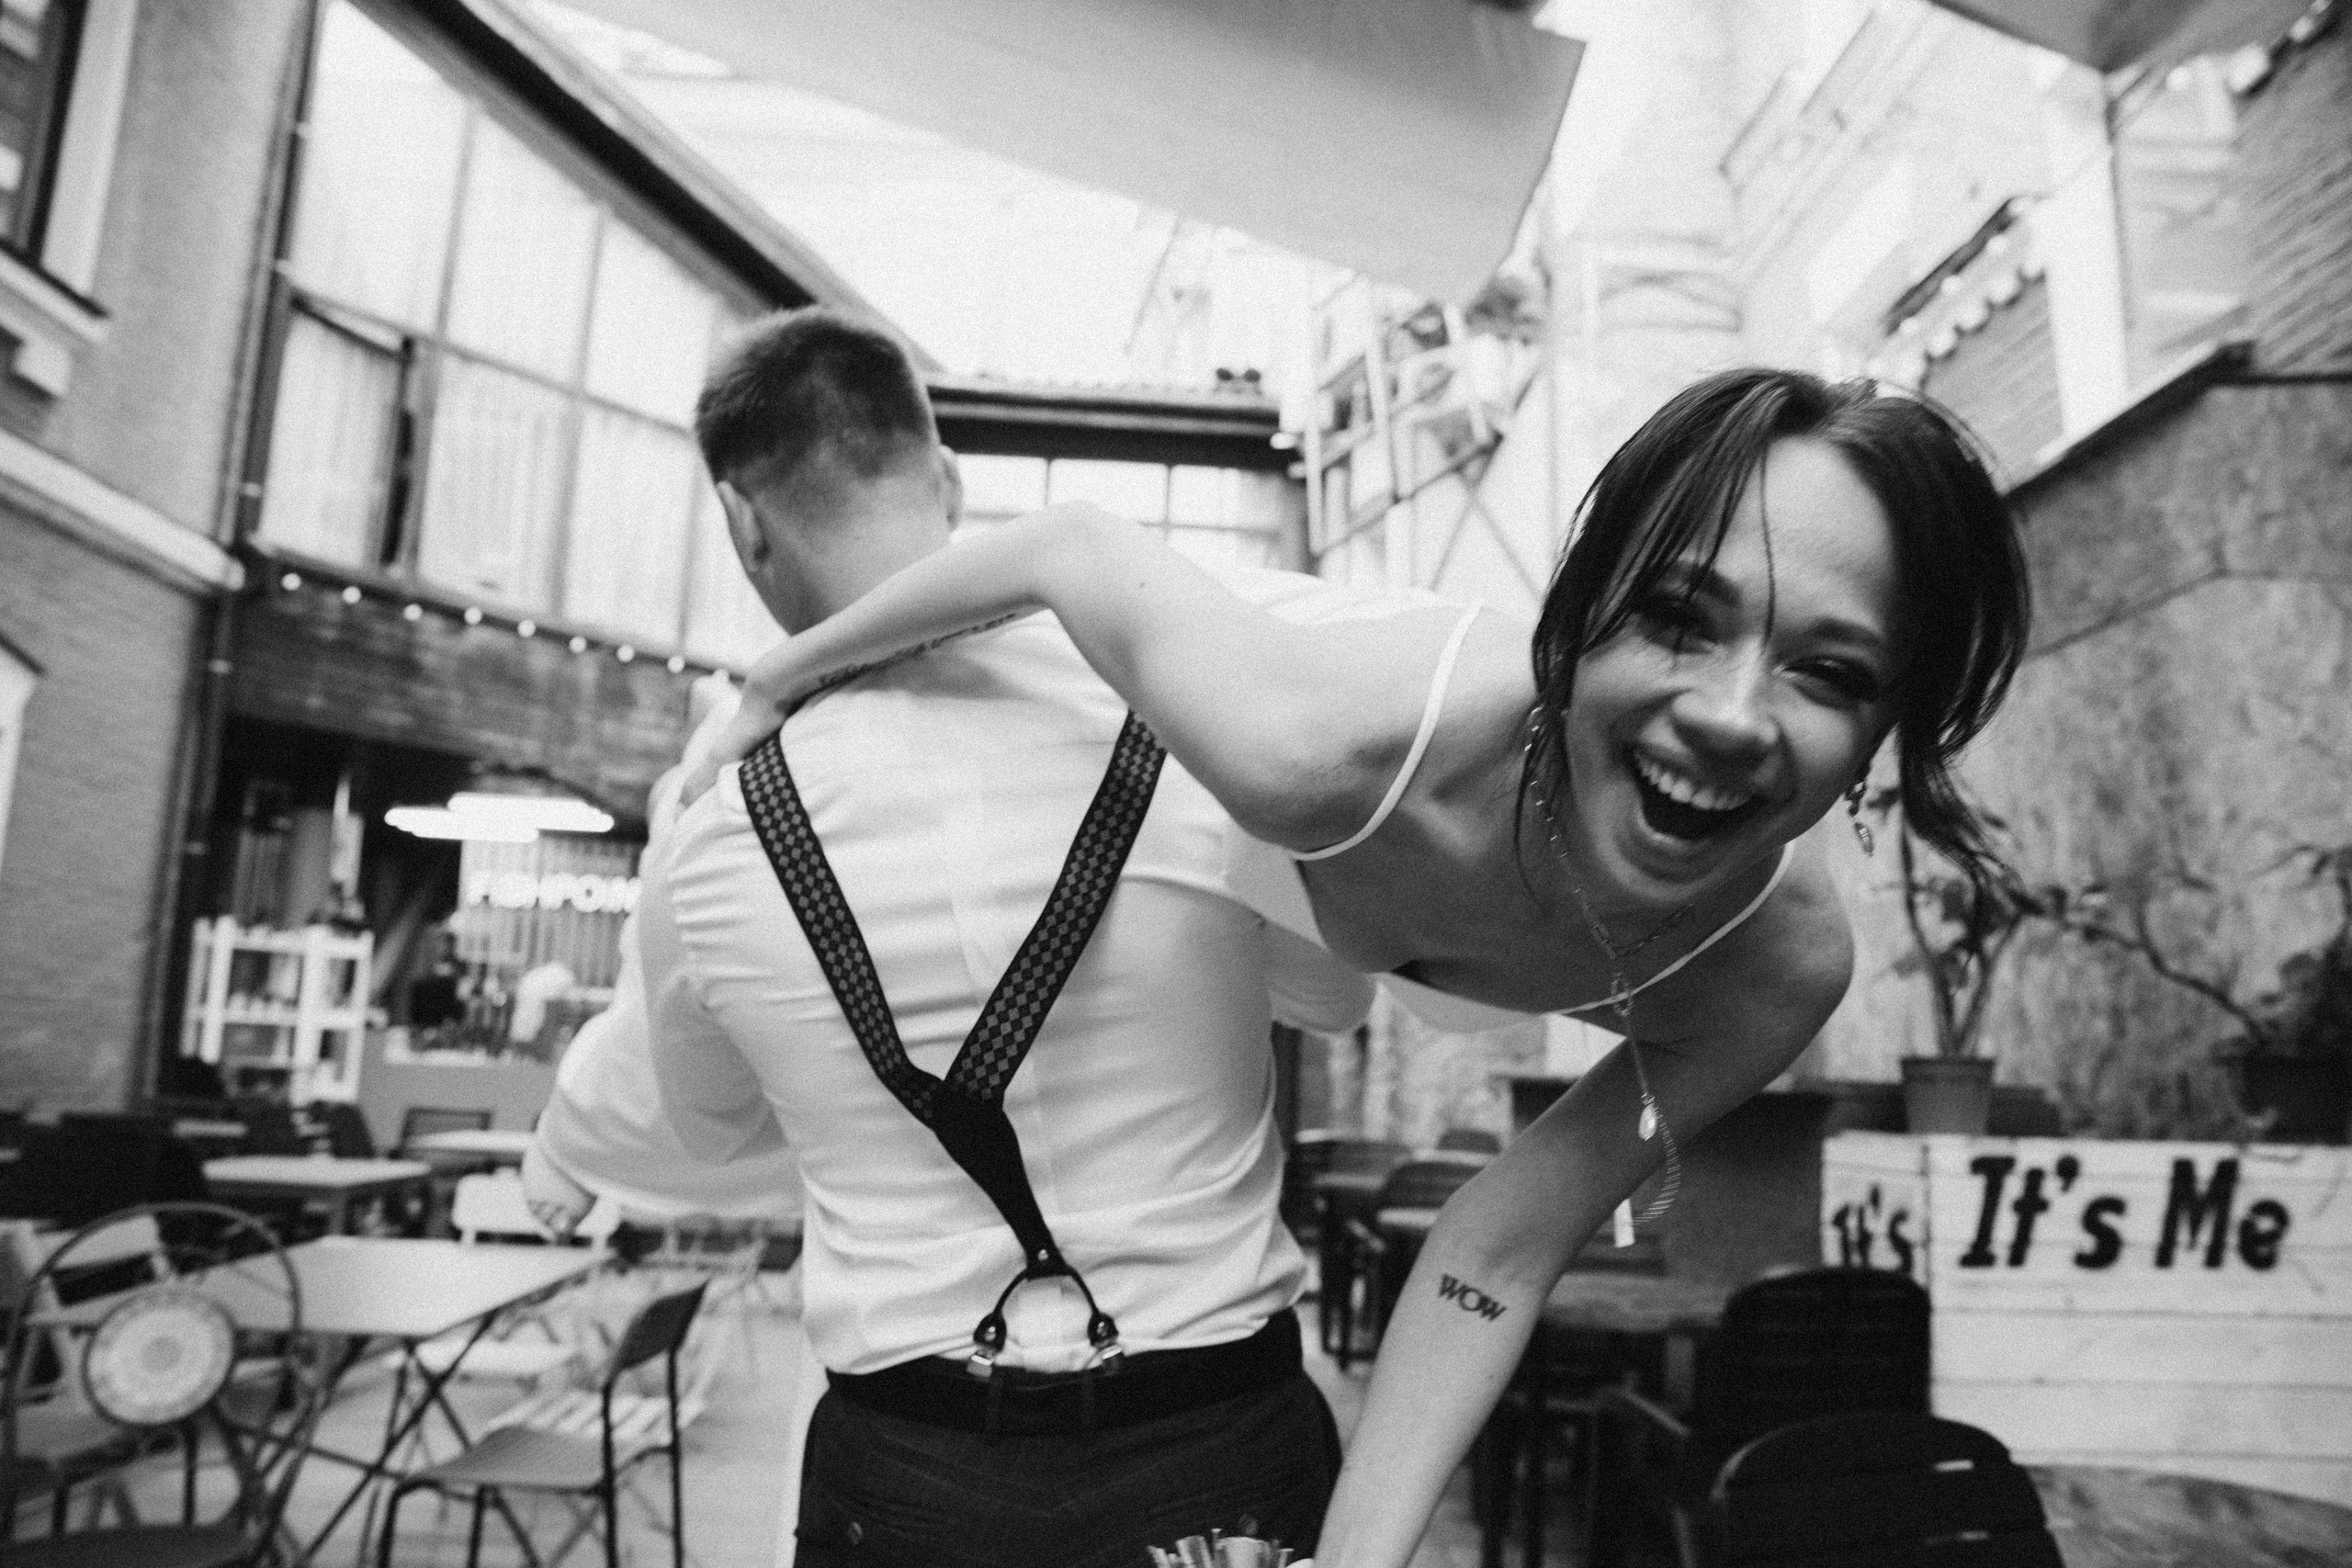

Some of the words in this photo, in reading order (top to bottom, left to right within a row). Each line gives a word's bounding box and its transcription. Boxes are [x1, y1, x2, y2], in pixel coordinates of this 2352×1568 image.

[1958, 1154, 2129, 1272] It's
[2154, 1156, 2291, 1272] Me
[1439, 1273, 1508, 1322] WOW
